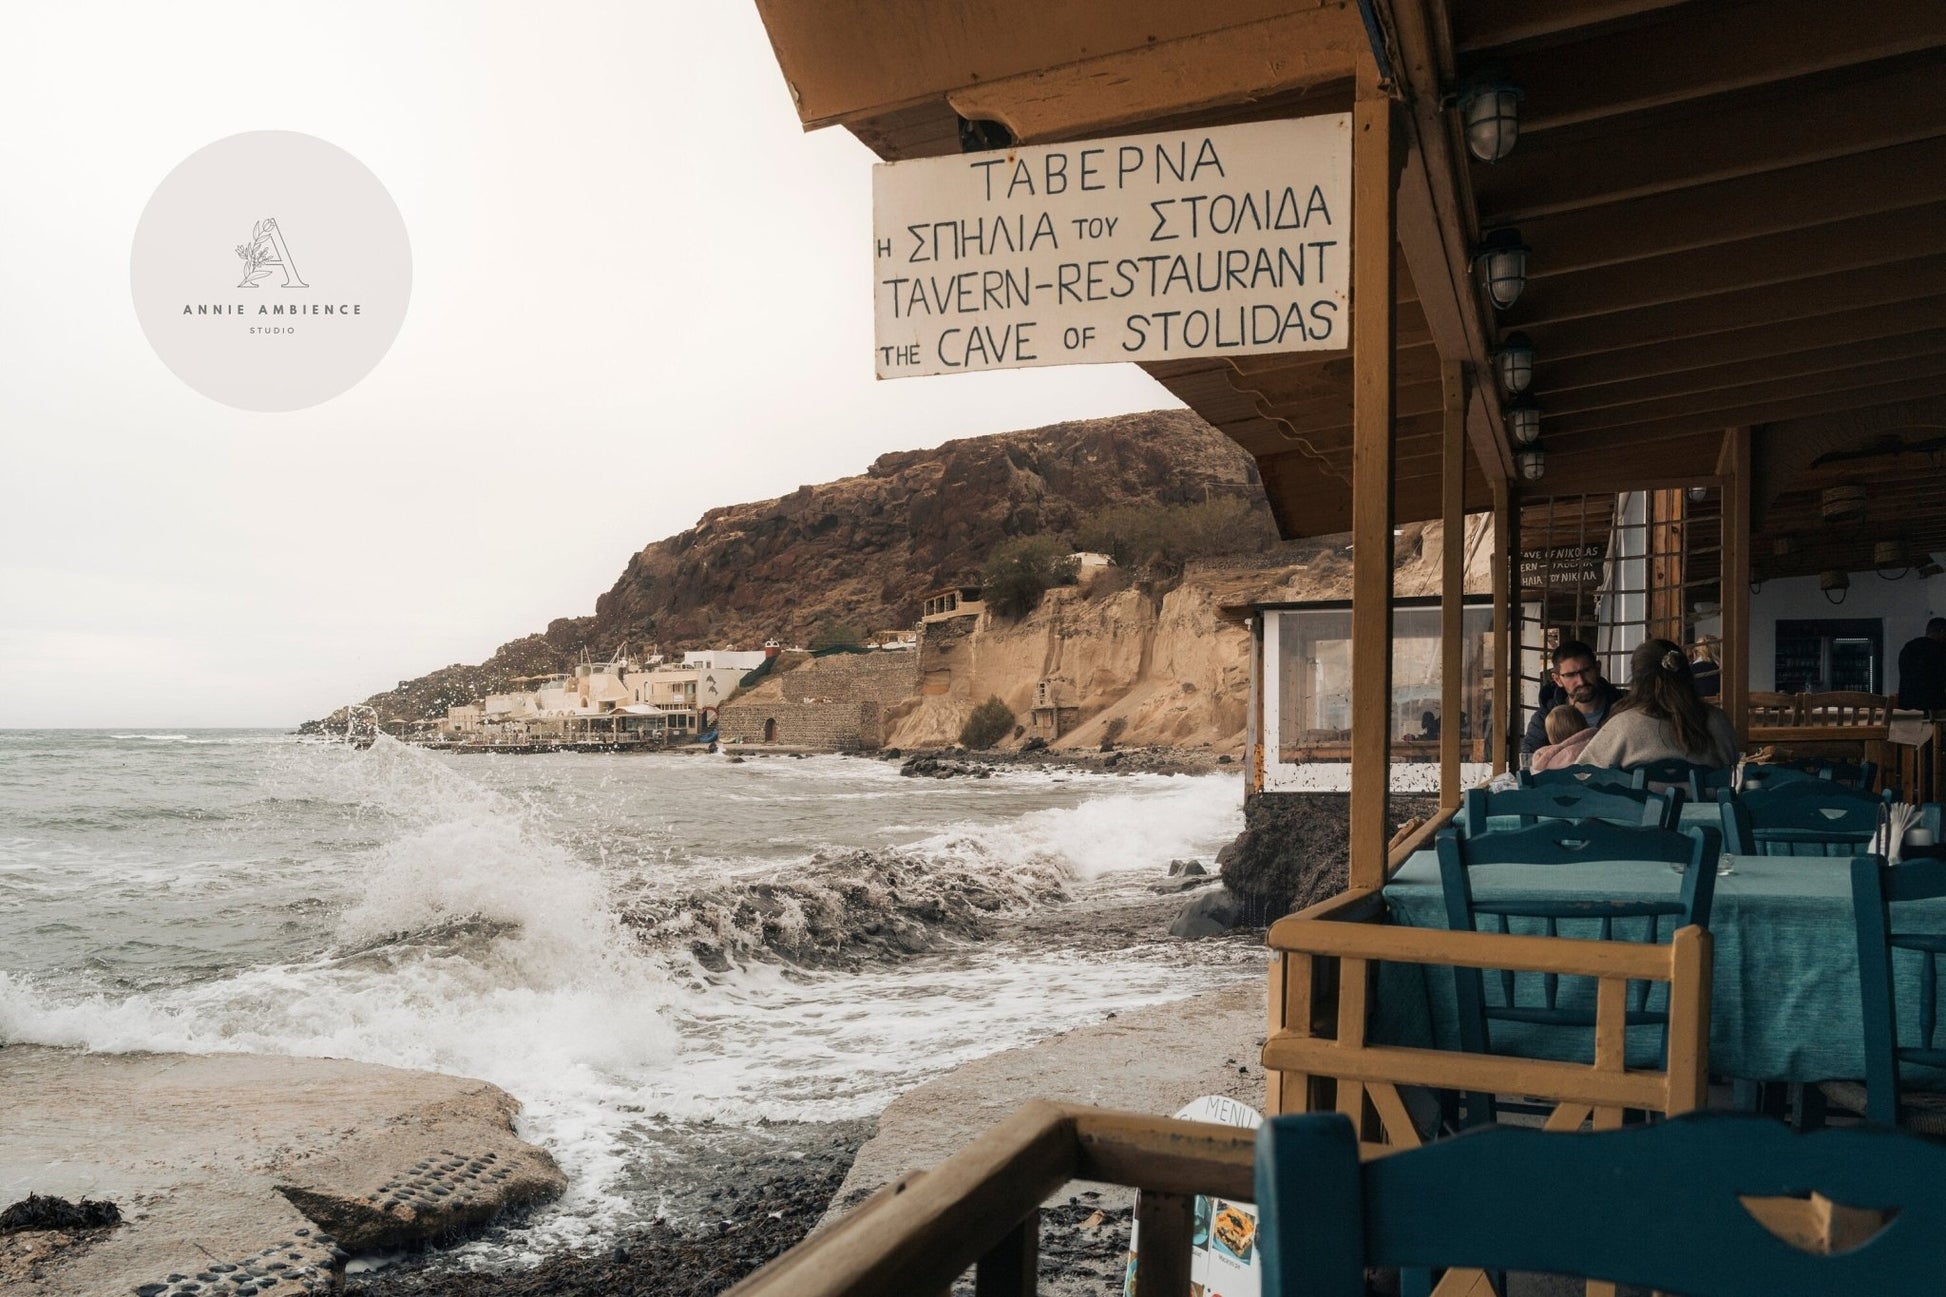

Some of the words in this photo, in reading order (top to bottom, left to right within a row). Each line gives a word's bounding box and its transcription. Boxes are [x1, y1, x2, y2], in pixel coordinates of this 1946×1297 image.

[969, 137, 1225, 202] ΤΑΒΕΡΝΑ
[877, 237, 891, 259] Η
[907, 211, 1059, 263] ΣΠΗΛΙΑ
[1071, 216, 1119, 240] ΤΟΥ
[1149, 184, 1332, 242] ΣΤΟΛΙΔΑ
[882, 240, 1338, 319] TAVERN-RESTAURANT
[879, 345, 921, 366] THE
[937, 321, 1038, 368] CAVE
[1063, 326, 1096, 350] OF
[1121, 299, 1338, 352] STOLIDAS
[1520, 551, 1542, 559] AVE
[1205, 1096, 1254, 1129] MENU
